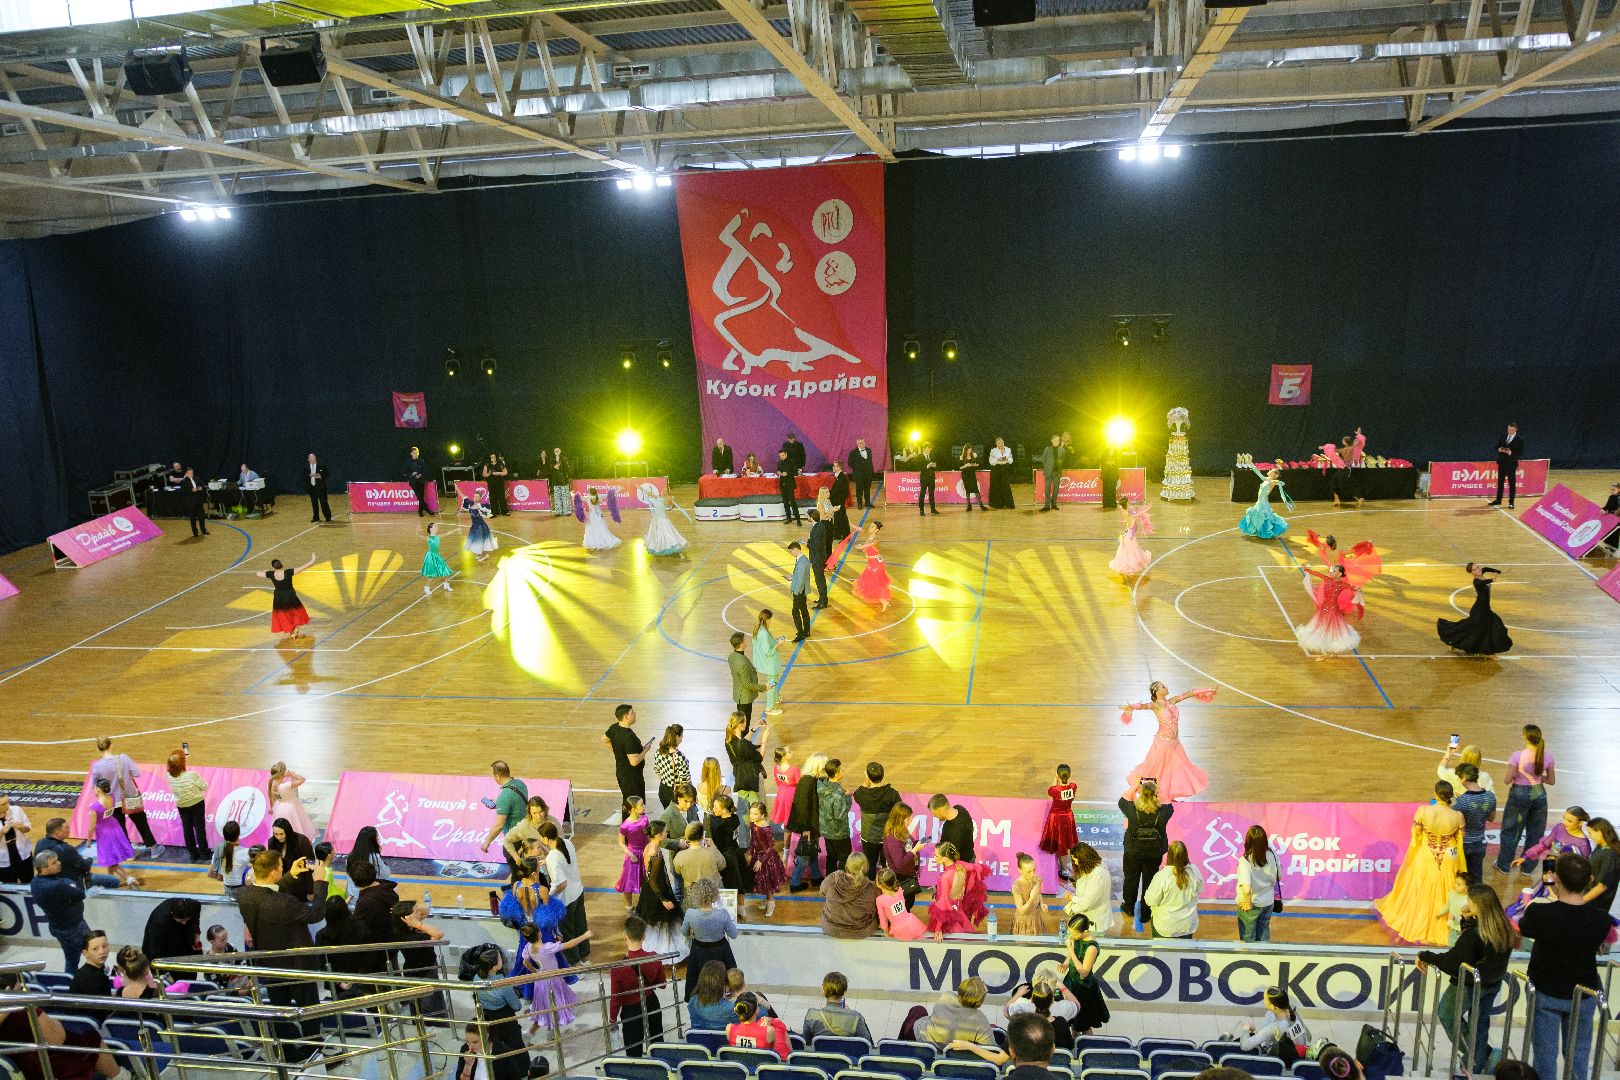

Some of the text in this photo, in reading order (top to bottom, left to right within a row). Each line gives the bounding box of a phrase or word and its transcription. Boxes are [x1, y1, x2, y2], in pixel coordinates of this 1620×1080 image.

[706, 373, 877, 400] Кубок Драйва
[1279, 377, 1303, 399] Б
[401, 404, 420, 423] А
[1452, 469, 1524, 481] ВЭЛЛКМ
[1059, 477, 1099, 491] Драйв
[712, 509, 719, 518] 2
[758, 507, 765, 517] 1
[417, 797, 478, 812] Танцуй с
[1268, 832, 1341, 855] Кубок
[1287, 853, 1392, 877] Драйва
